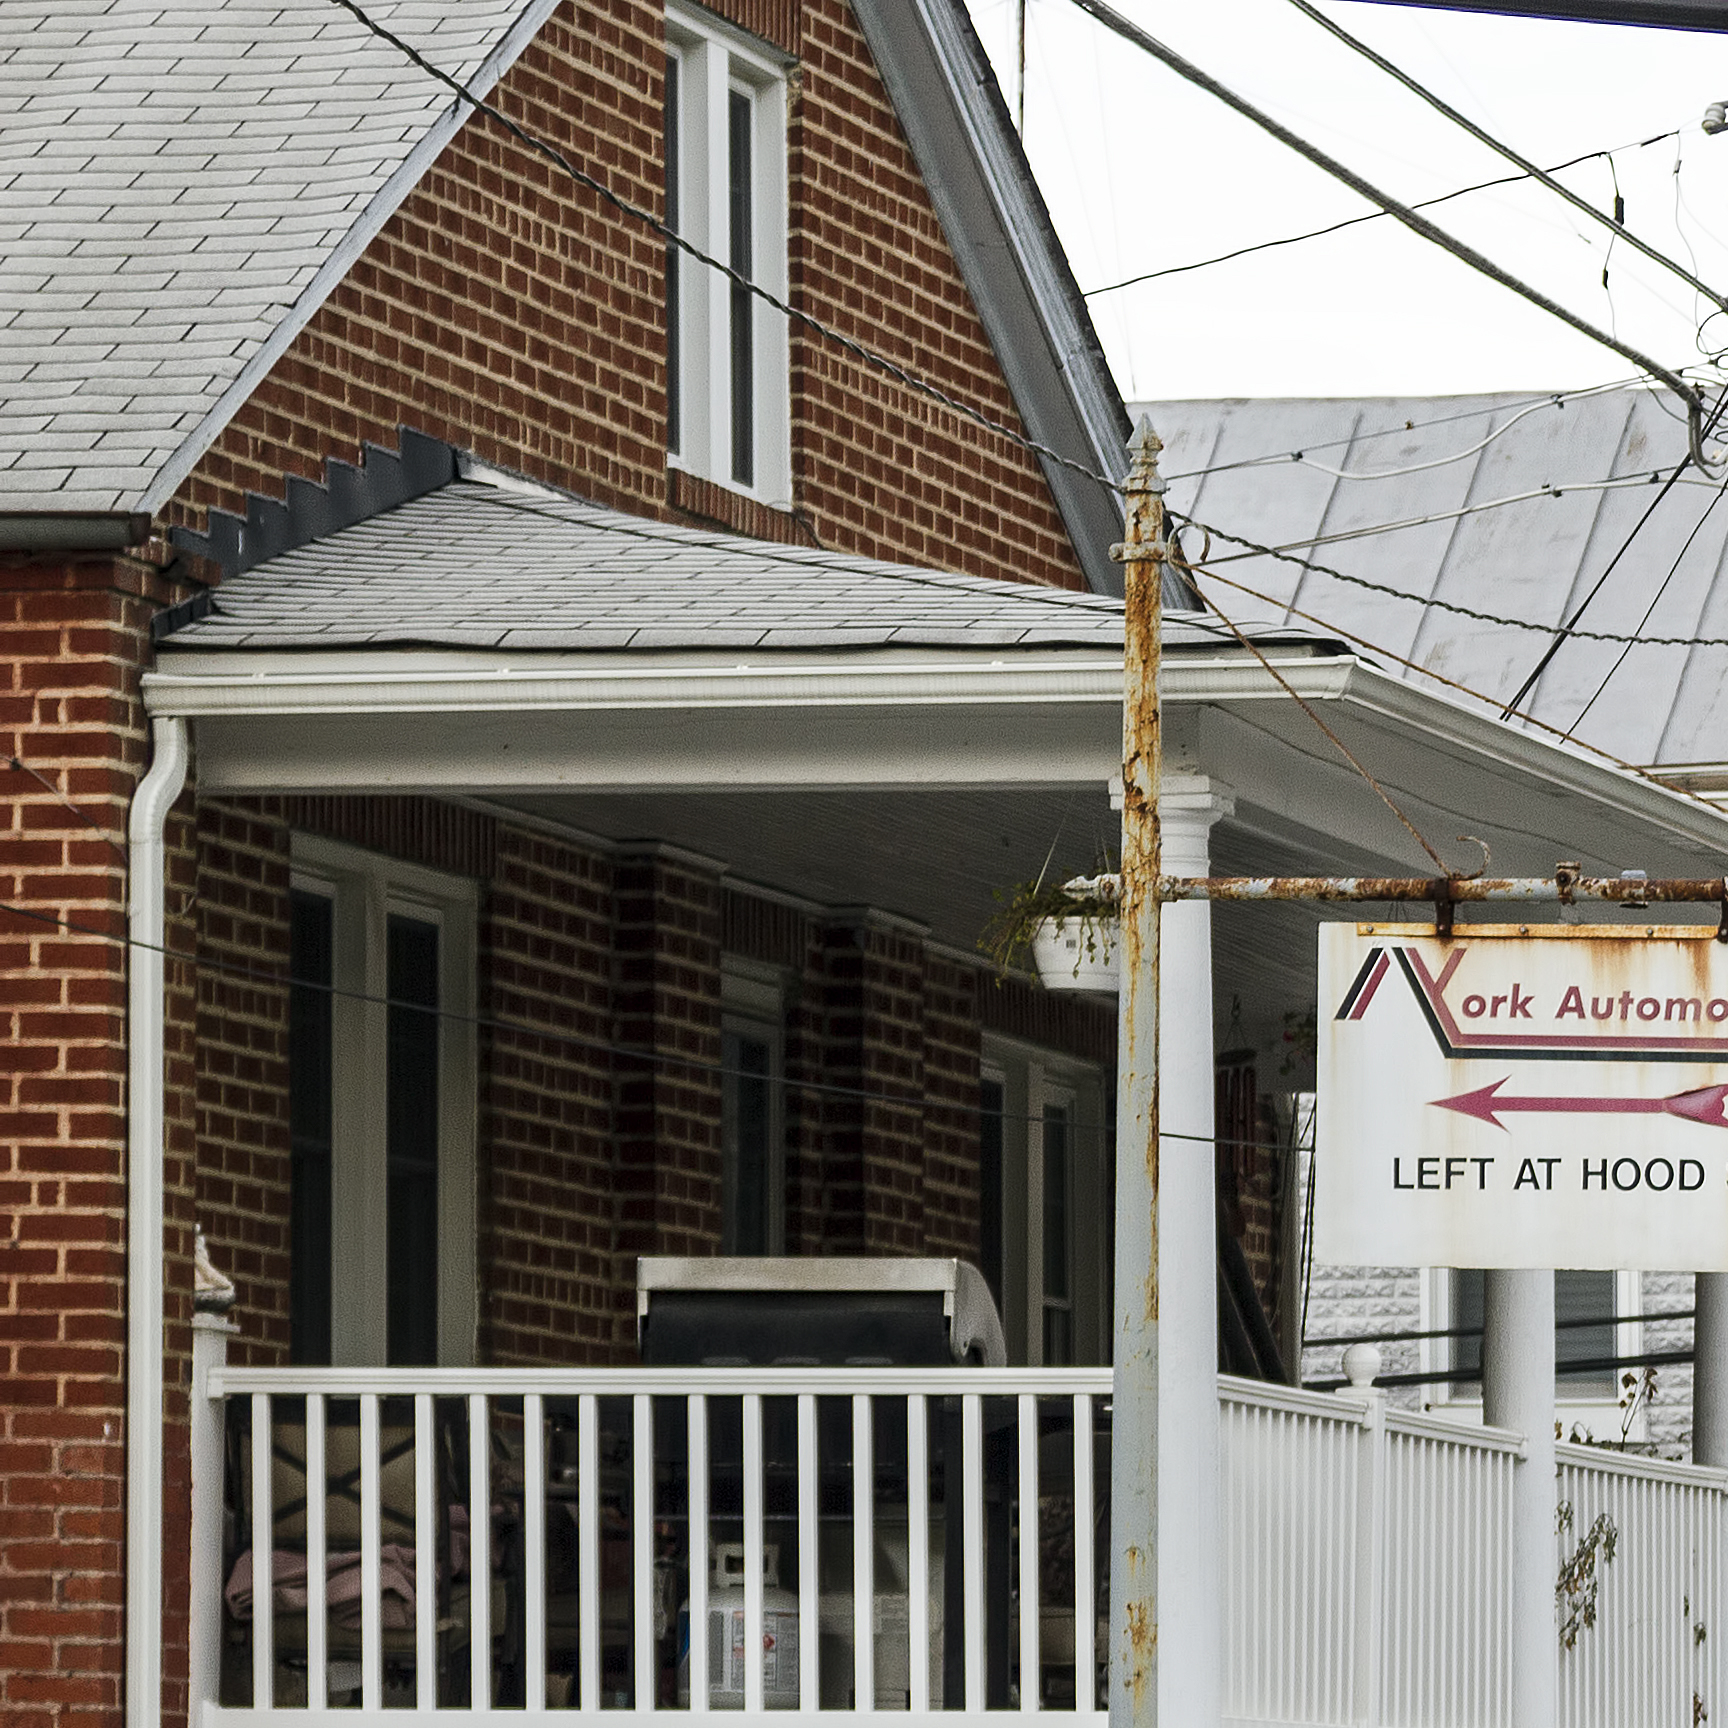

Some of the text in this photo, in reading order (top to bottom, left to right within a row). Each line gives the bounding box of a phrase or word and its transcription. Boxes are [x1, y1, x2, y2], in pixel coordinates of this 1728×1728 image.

[1393, 1157, 1494, 1190] LEFT
[1514, 1157, 1562, 1190] AT
[1582, 1157, 1705, 1191] HOOD
